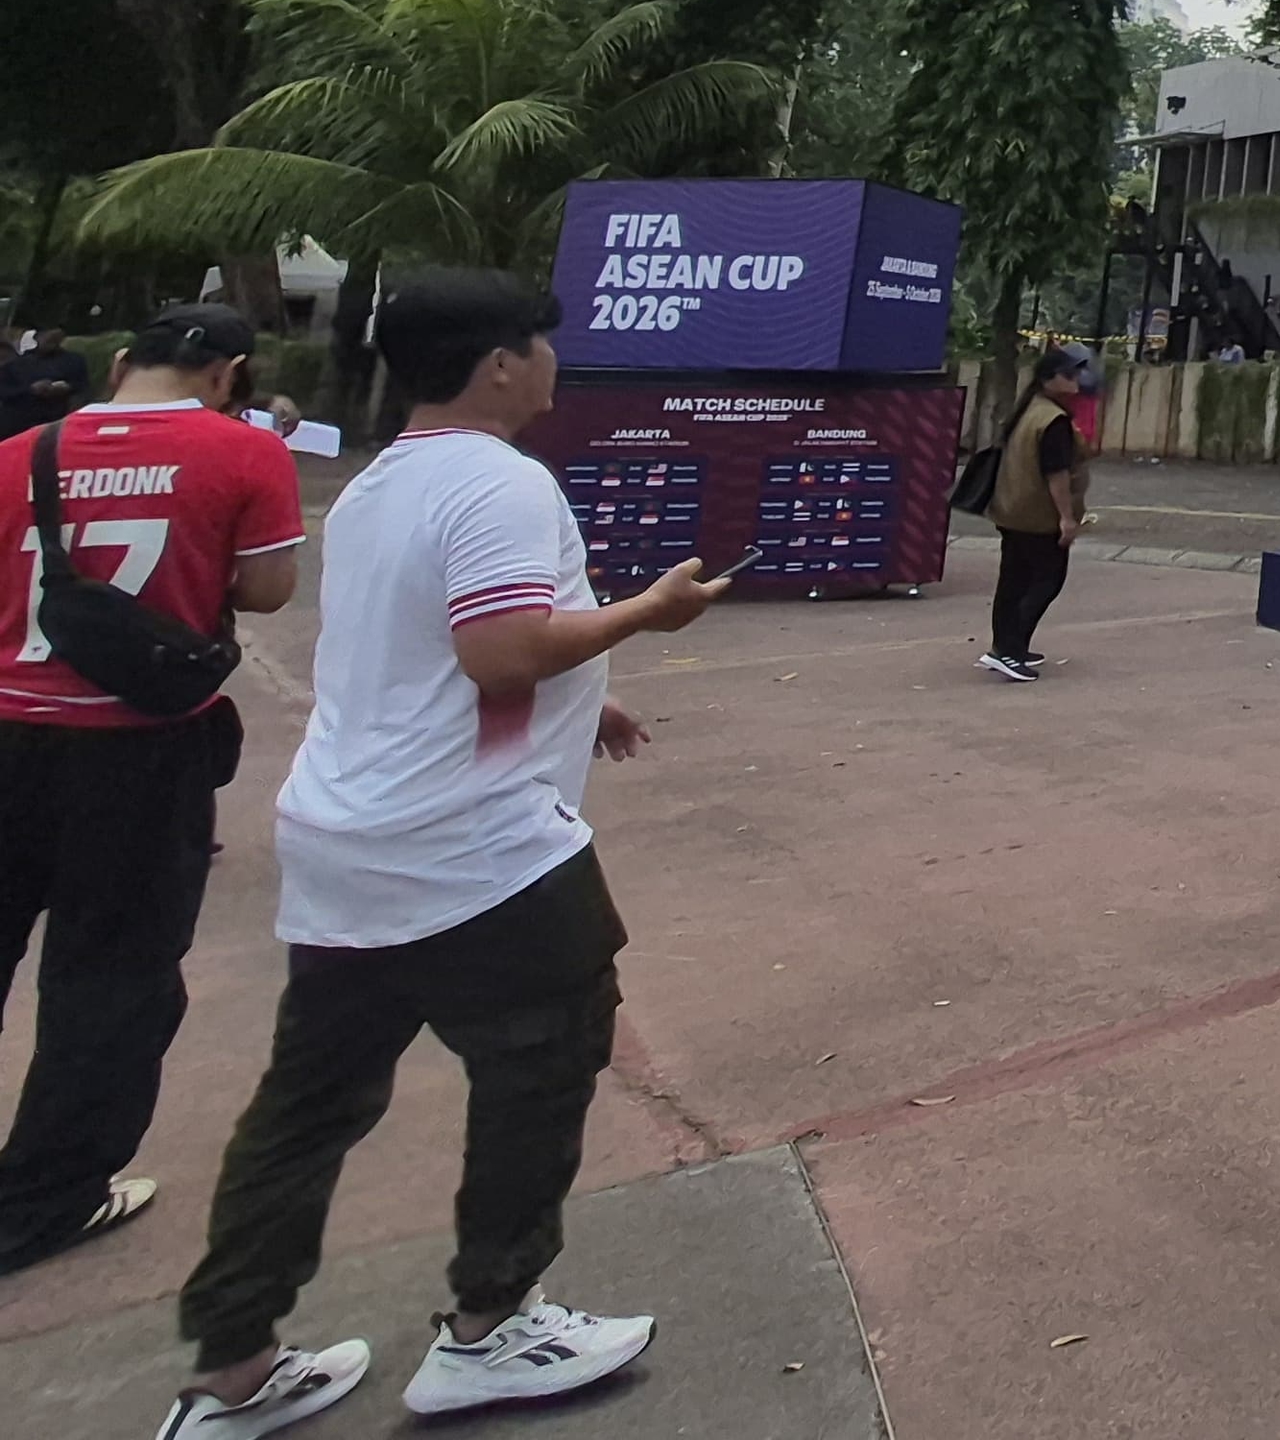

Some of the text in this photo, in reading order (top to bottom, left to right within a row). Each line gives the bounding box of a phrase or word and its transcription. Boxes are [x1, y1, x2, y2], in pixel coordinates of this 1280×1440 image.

[605, 214, 682, 248] FIFA
[595, 254, 804, 291] ASEAN CUP
[662, 398, 826, 411] MATCH SCHEDULE
[611, 429, 670, 440] JAKARTA
[807, 429, 866, 439] BANDUNG
[28, 465, 181, 502] ERDONK
